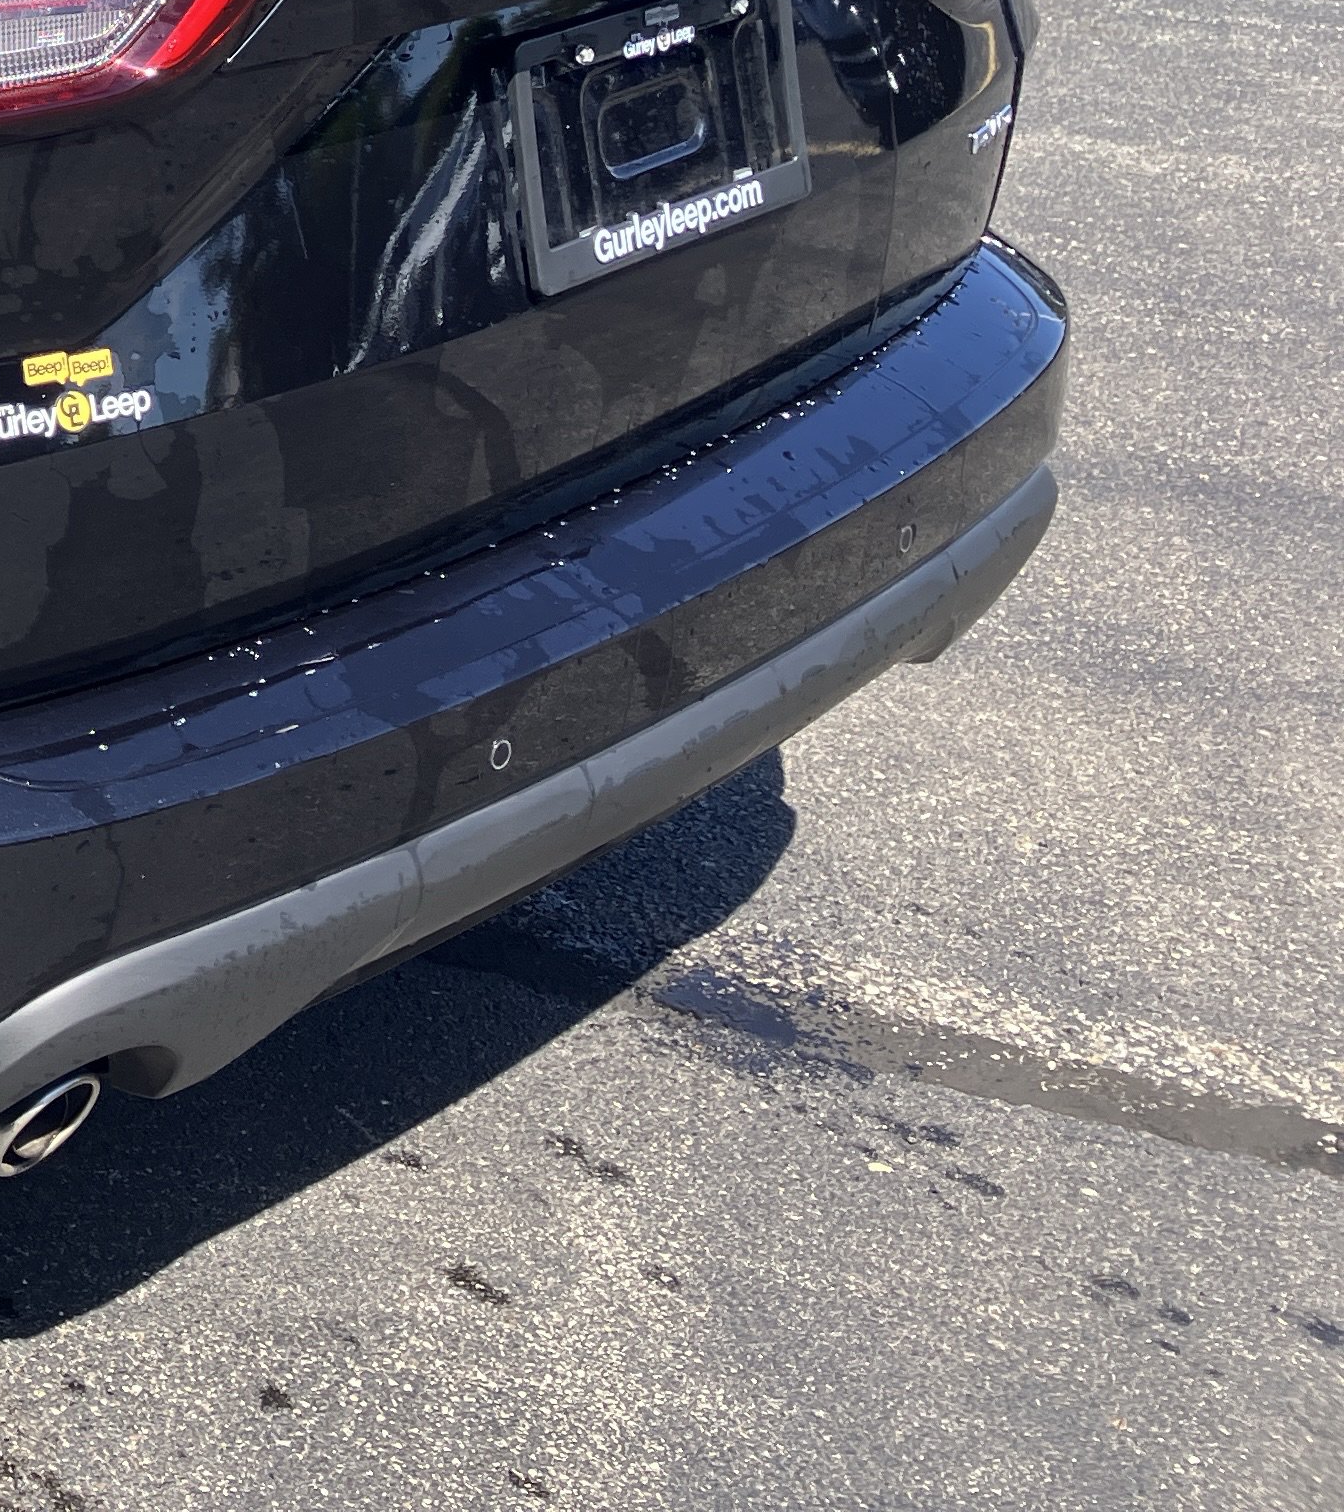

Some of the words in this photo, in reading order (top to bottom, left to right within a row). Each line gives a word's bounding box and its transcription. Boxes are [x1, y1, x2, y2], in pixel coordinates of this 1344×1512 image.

[593, 180, 764, 264] Gurleyleep.com
[27, 359, 67, 378] Beep!
[72, 355, 111, 375] Beep!
[89, 389, 151, 421] Leep
